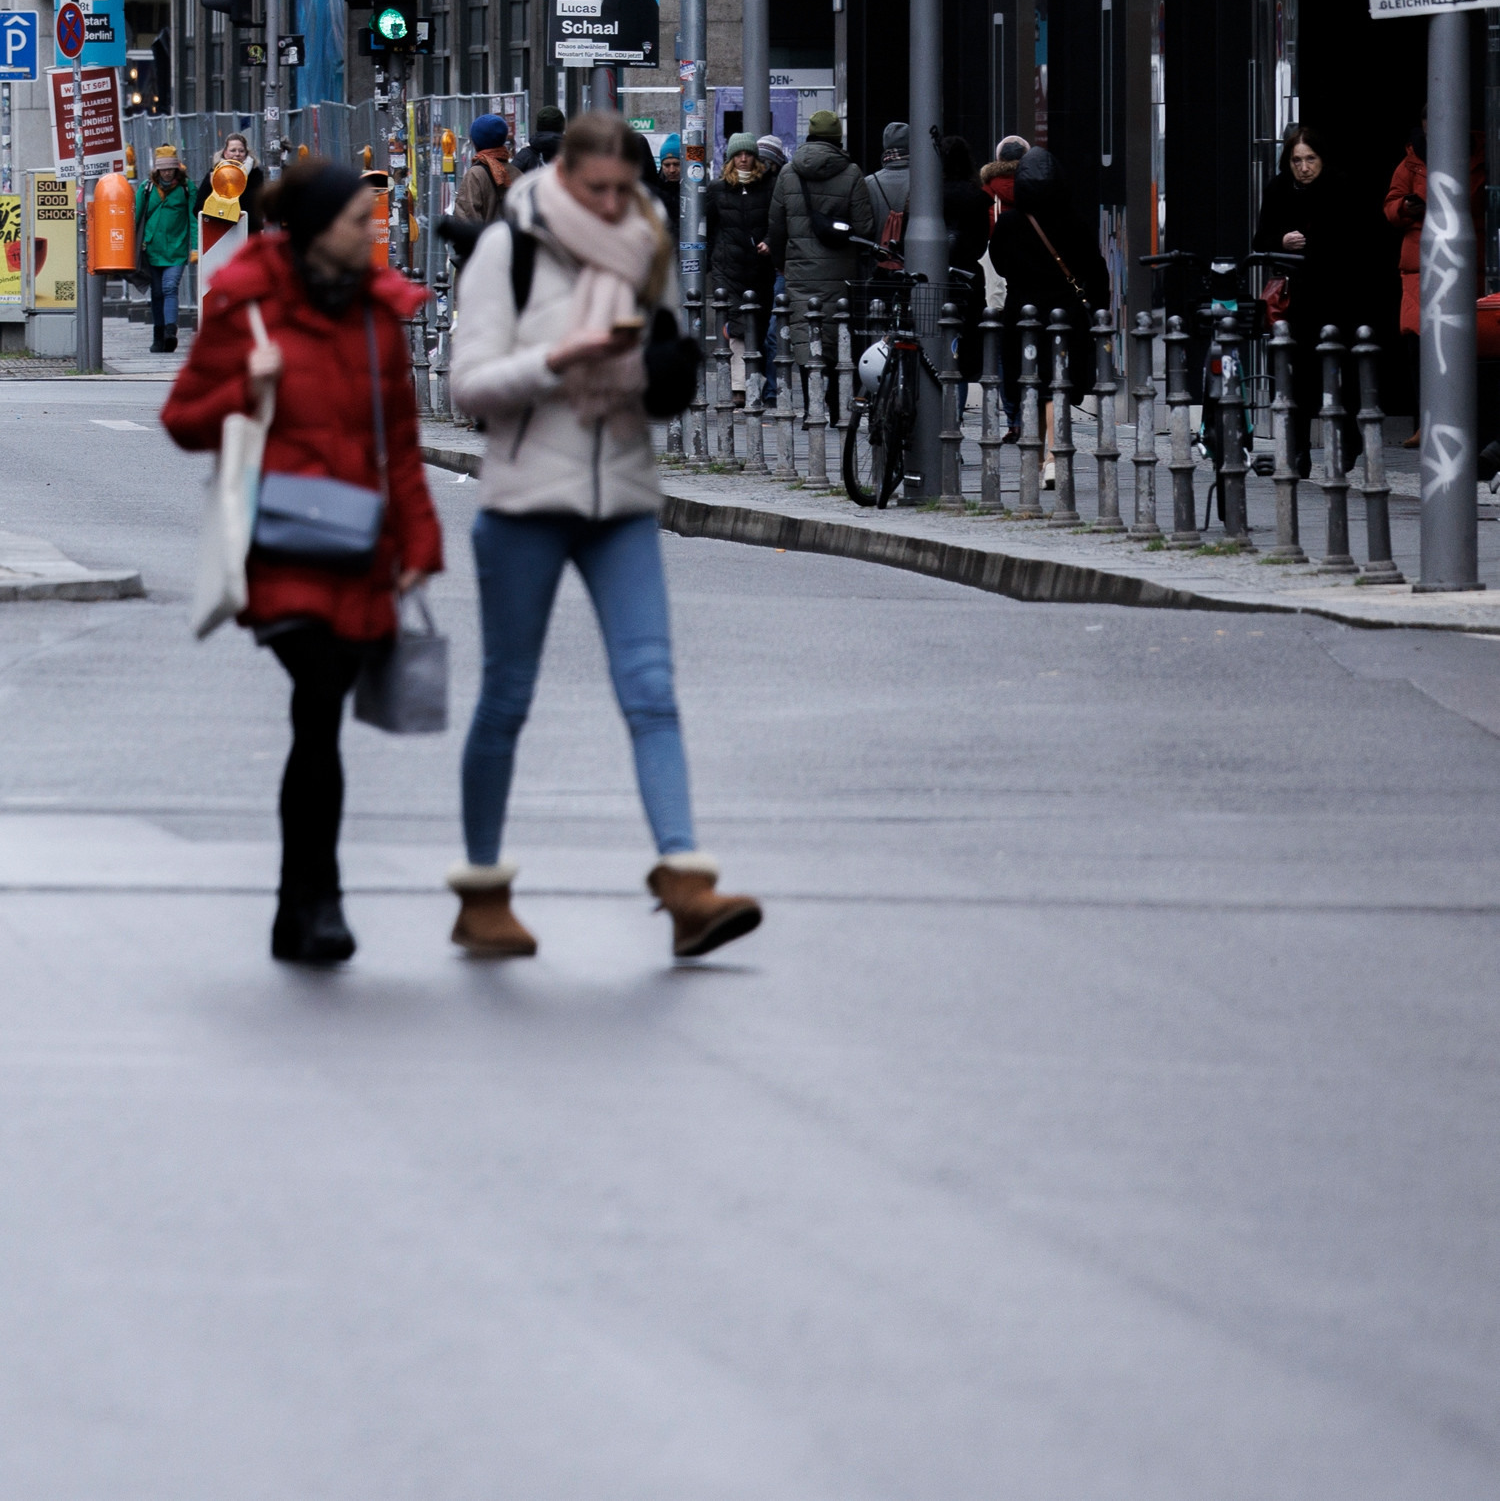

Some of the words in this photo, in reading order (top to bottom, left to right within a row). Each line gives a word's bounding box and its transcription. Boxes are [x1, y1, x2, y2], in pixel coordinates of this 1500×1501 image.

[561, 3, 597, 14] Lucas
[562, 20, 619, 35] Schaal
[7, 29, 27, 65] P
[84, 109, 95, 117] FÜR
[85, 127, 114, 139] BILDUNG
[38, 181, 66, 191] SOUL
[38, 196, 67, 206] FOOD
[38, 210, 74, 219] SHOCK
